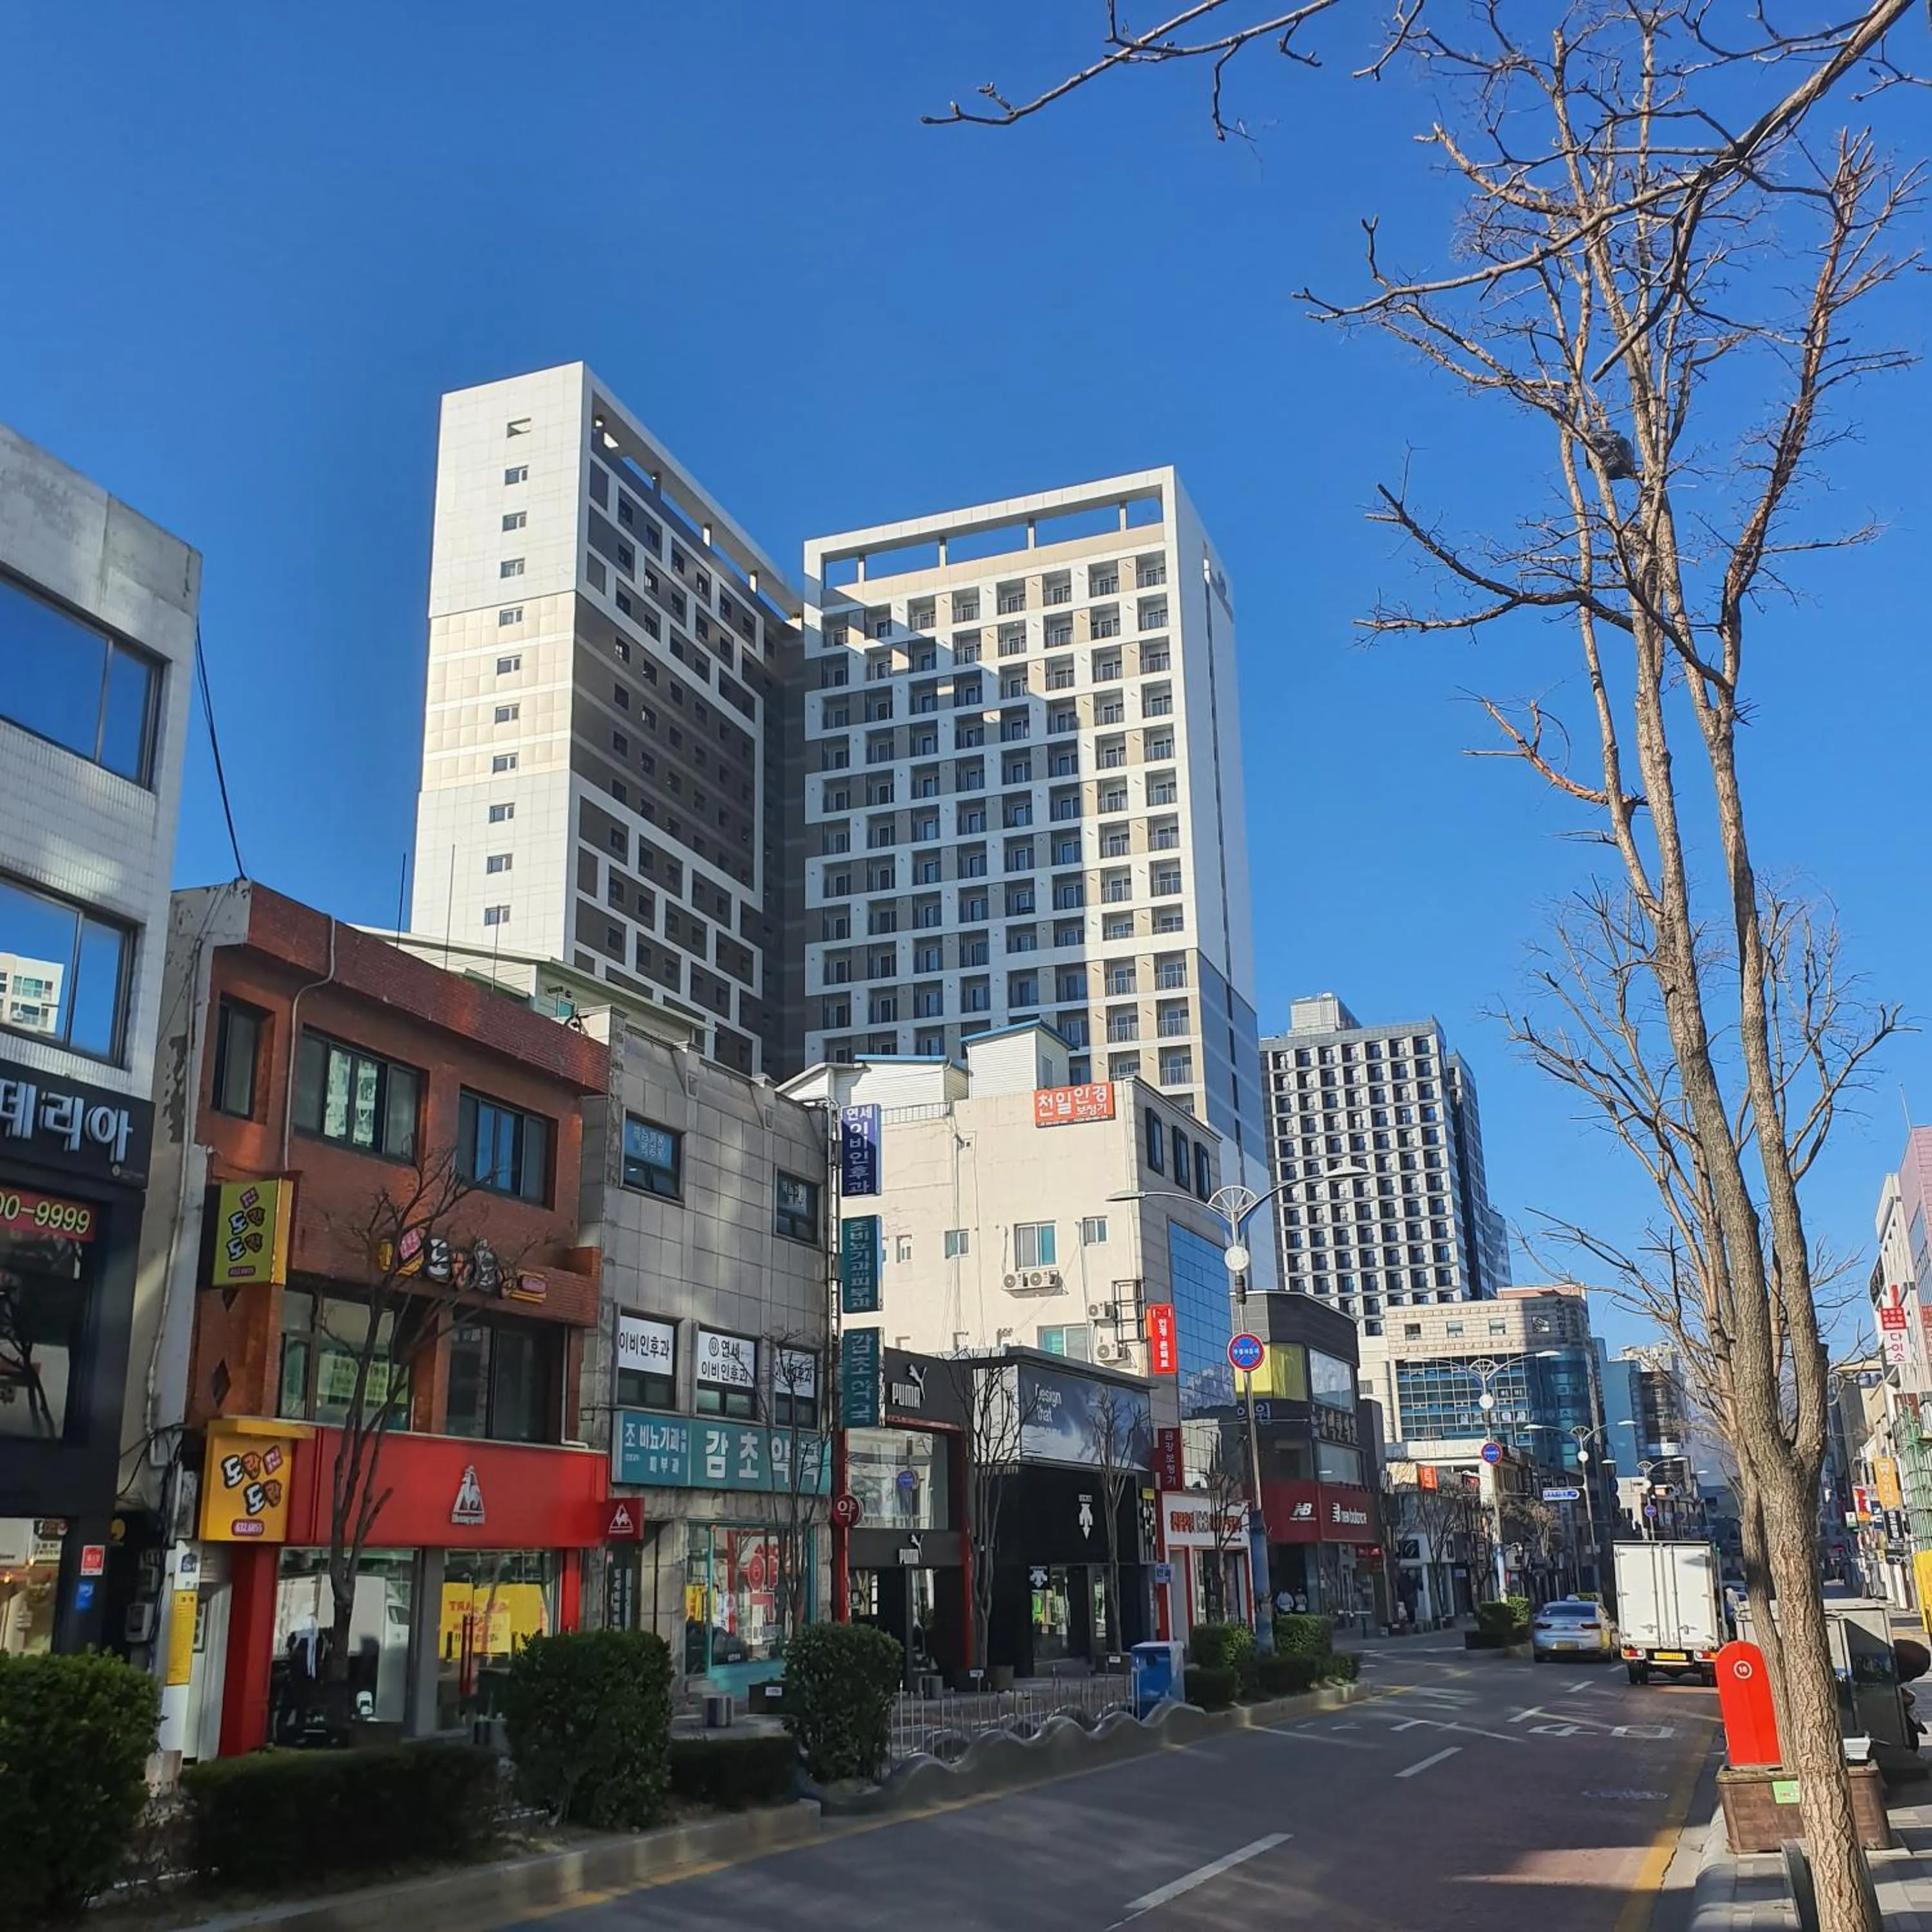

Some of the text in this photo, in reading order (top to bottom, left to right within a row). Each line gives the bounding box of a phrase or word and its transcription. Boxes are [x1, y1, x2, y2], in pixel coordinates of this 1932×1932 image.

[847, 1106, 873, 1121] 연세
[1037, 1084, 1108, 1117] 천일안경
[1076, 1103, 1108, 1116] 보청기
[848, 1121, 869, 1193] 이비인후과
[0, 1195, 90, 1235] 0-9999
[619, 1331, 670, 1361] 이비인후과
[721, 1340, 740, 1359] 연세
[1889, 1332, 1905, 1363] 다이소
[701, 1360, 749, 1383] 이비인후과
[850, 1334, 874, 1423] 감초약국
[892, 1383, 920, 1409] PUMA
[705, 1429, 821, 1486] 감초약국
[837, 1501, 855, 1520] 약
